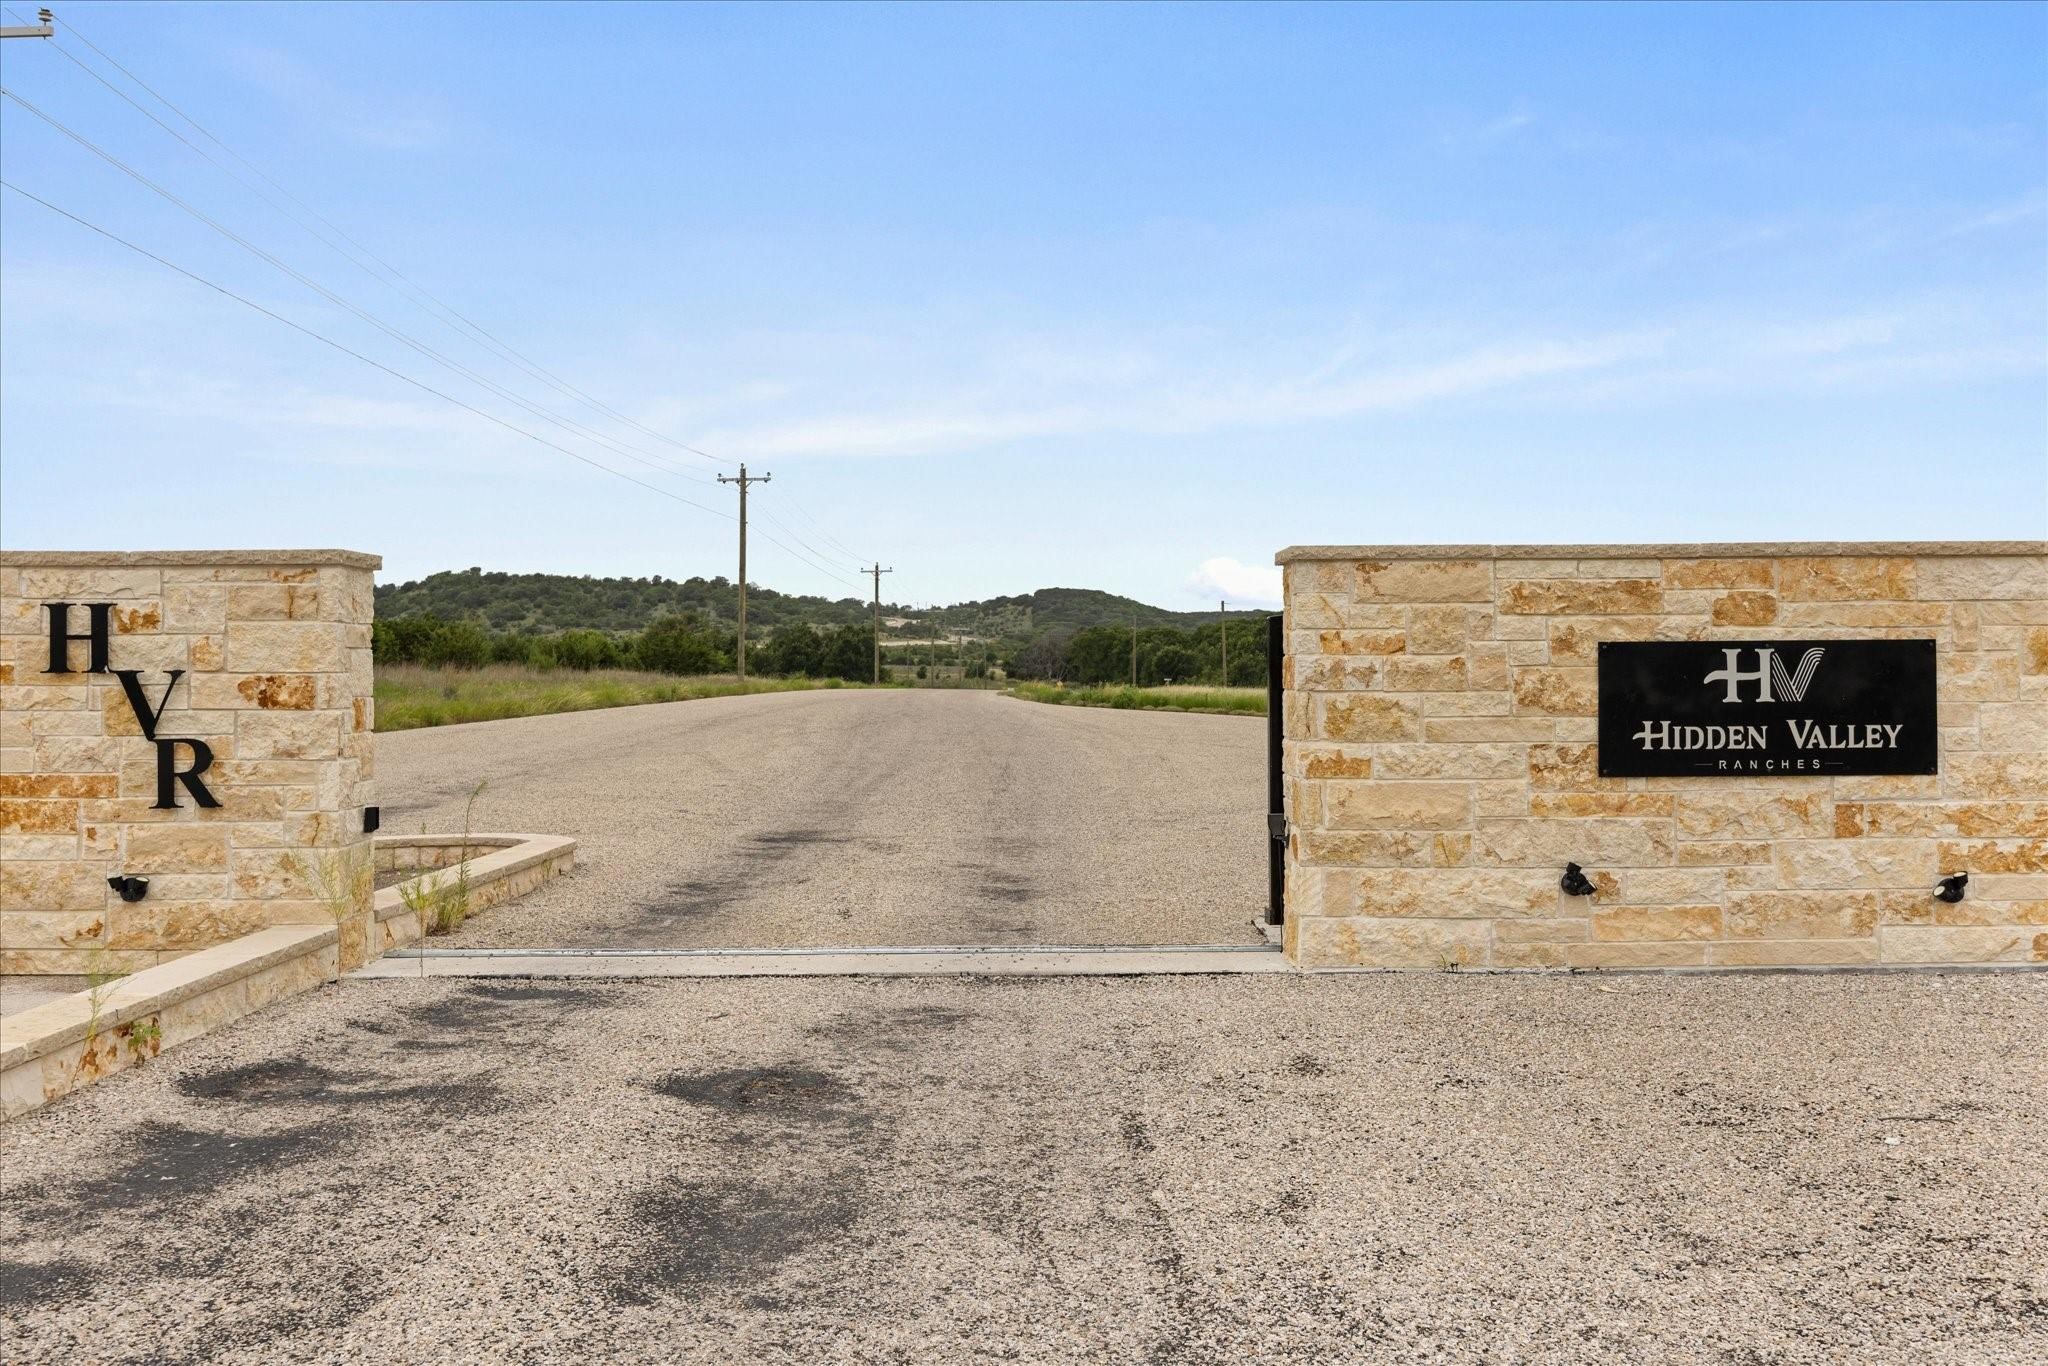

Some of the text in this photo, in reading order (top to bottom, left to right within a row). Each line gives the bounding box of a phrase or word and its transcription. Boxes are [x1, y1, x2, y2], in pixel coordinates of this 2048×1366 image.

[1703, 647, 1826, 703] HV
[1632, 719, 1903, 750] HIDDEN VALLEY
[1718, 759, 1820, 770] RANCHES
